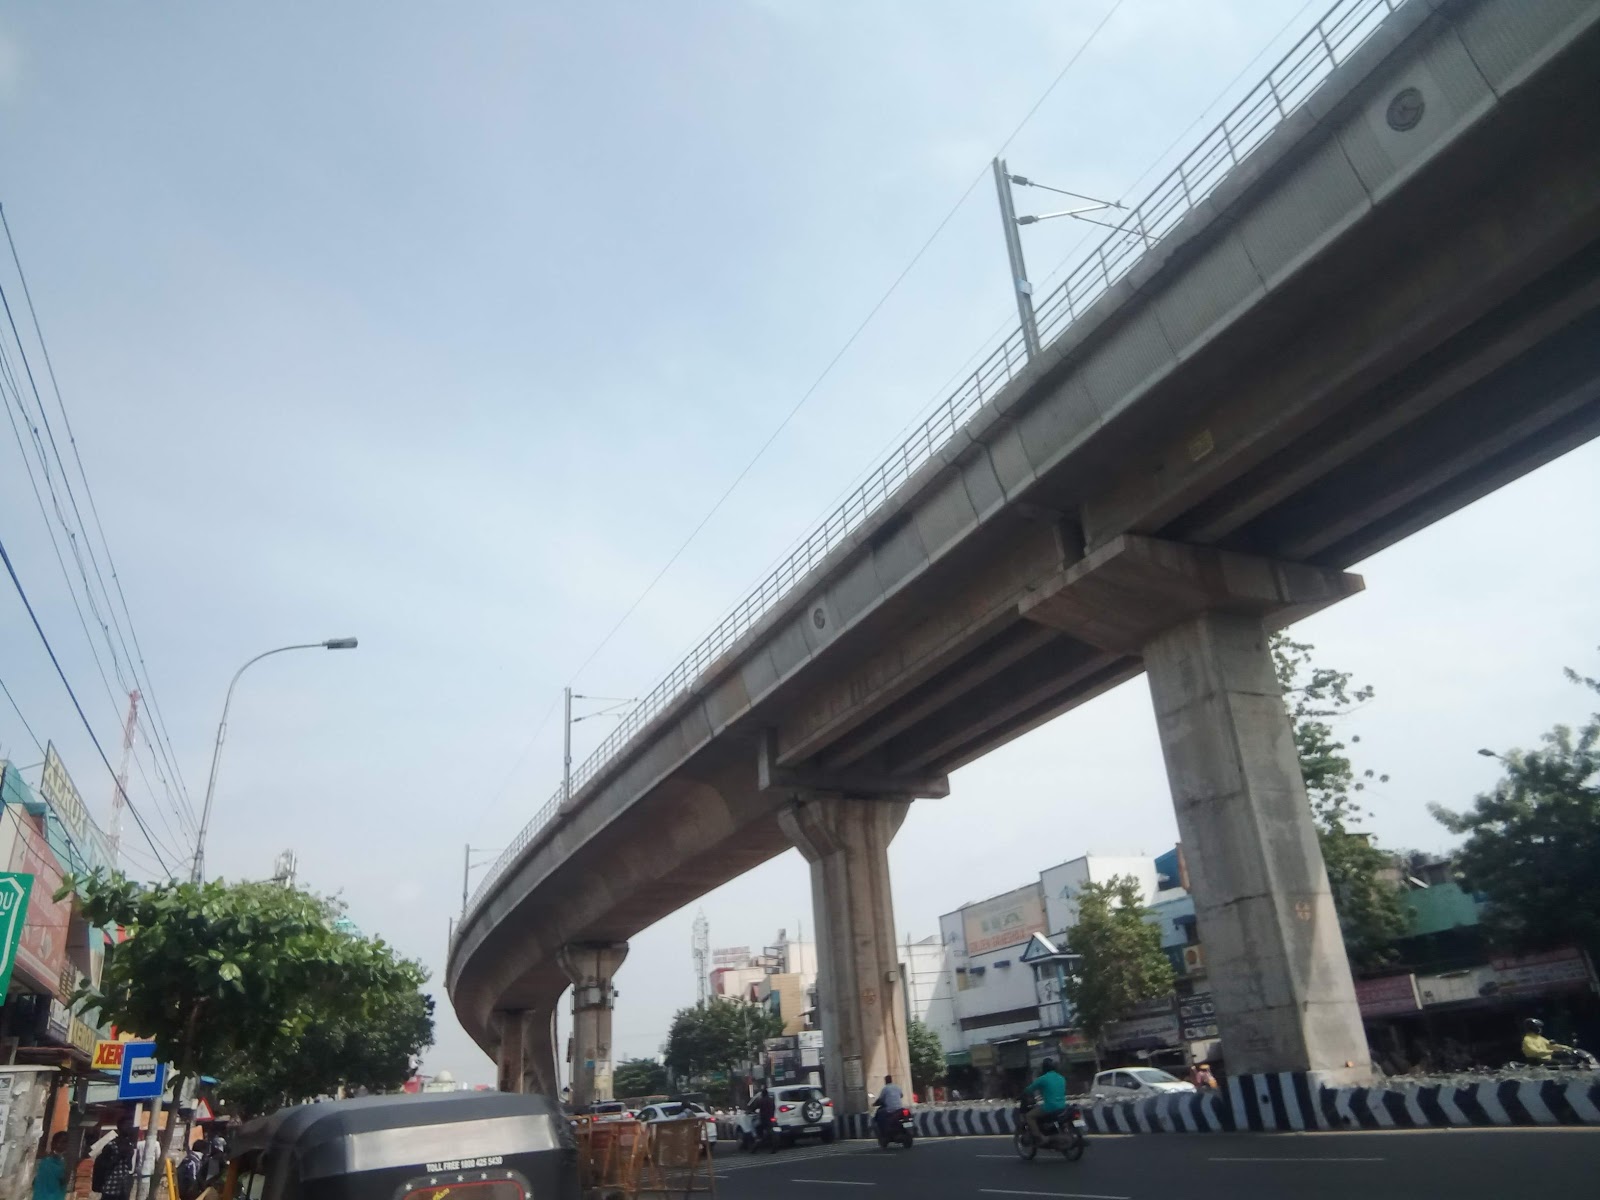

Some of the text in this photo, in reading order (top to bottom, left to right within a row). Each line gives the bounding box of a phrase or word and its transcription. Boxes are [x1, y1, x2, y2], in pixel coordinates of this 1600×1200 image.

[43, 745, 87, 840] XEROX
[426, 1163, 443, 1172] TOLL
[443, 1161, 460, 1171] FREE
